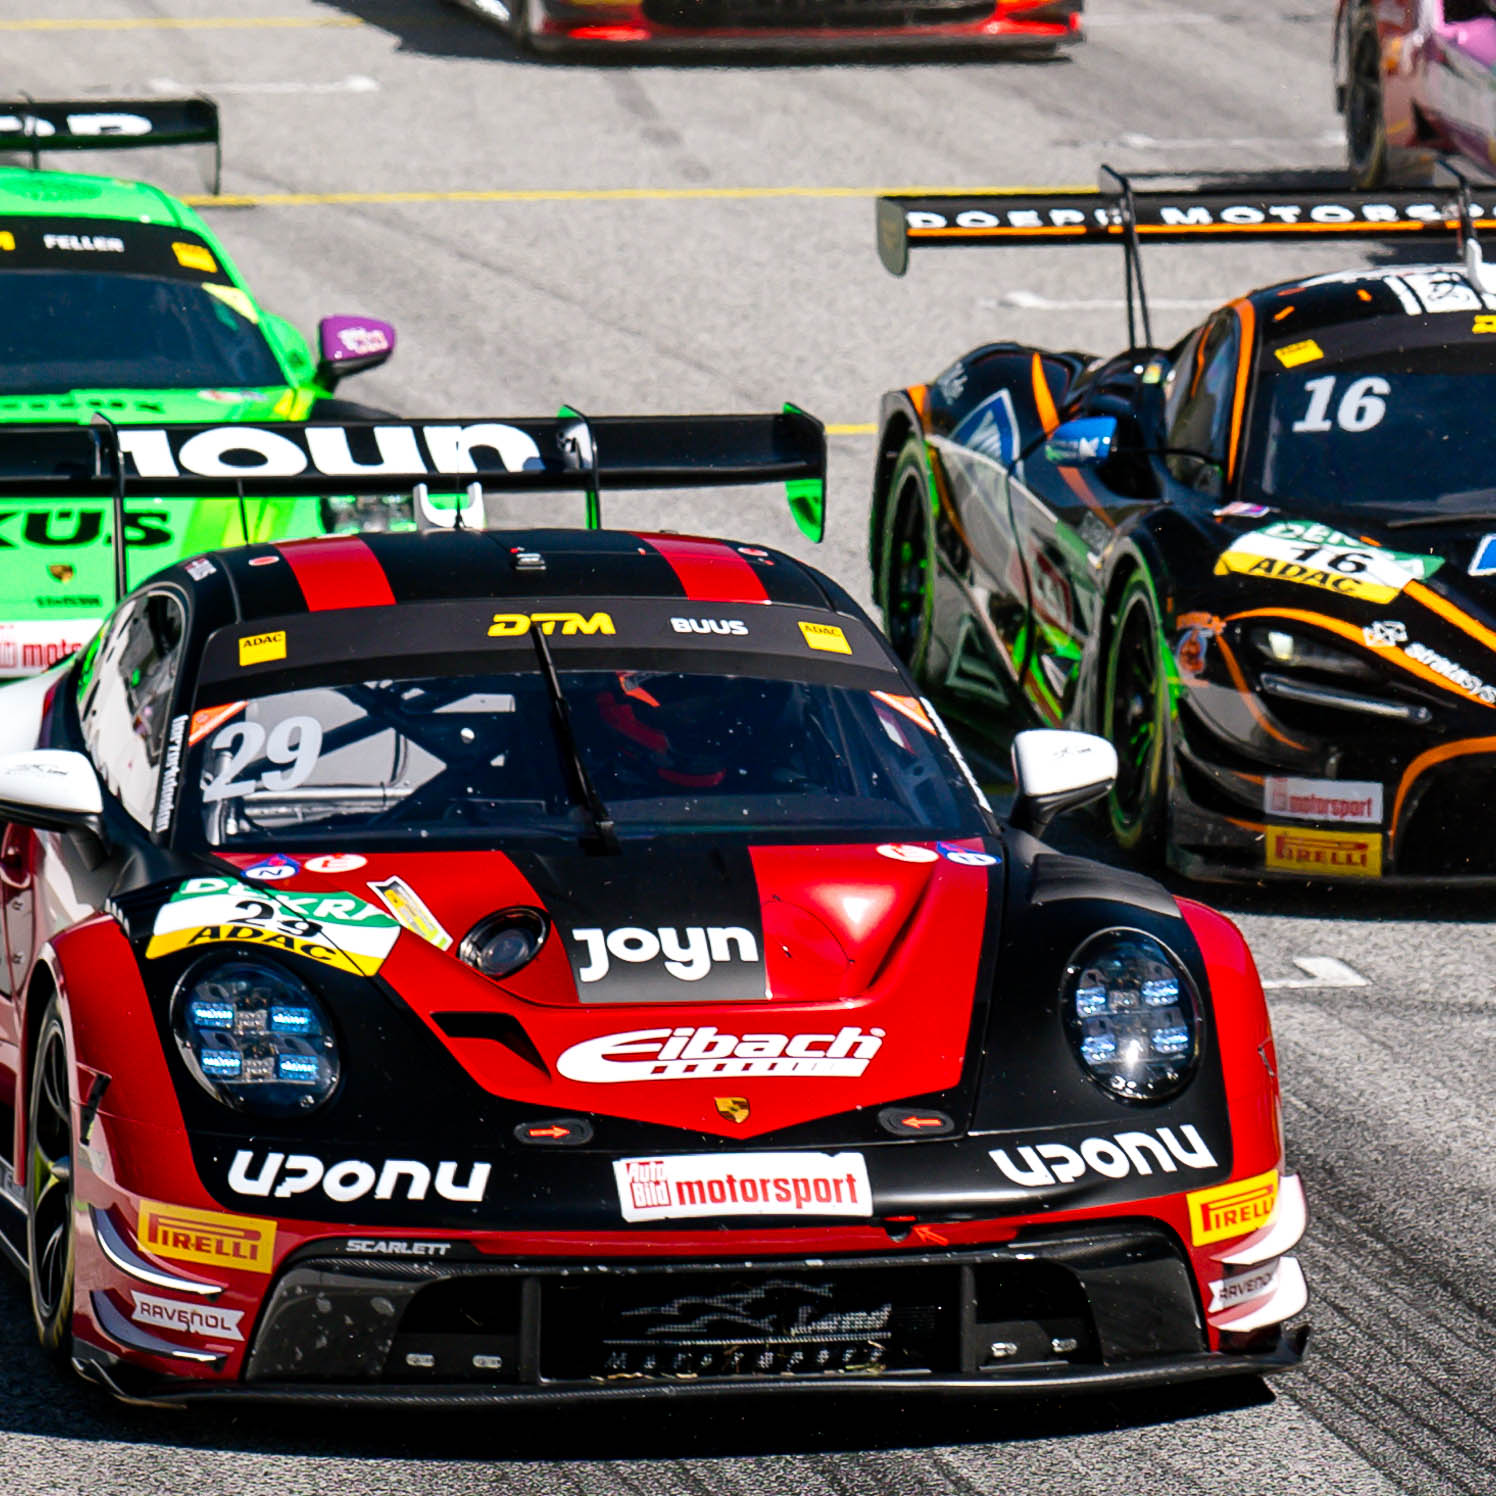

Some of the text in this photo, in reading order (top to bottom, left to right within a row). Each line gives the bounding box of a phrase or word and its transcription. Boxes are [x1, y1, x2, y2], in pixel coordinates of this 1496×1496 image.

[43, 234, 126, 253] FELLER
[1292, 375, 1392, 433] 16
[1248, 557, 1364, 594] ADAC
[1280, 545, 1373, 575] 16
[242, 634, 283, 648] ADAC
[487, 612, 750, 637] DTM BUUS
[803, 625, 842, 638] ADAC
[202, 715, 323, 803] 29
[1275, 835, 1369, 867] PIRELLI
[226, 899, 323, 938] 29
[187, 925, 338, 961] ADAC
[572, 926, 760, 981] joyn
[556, 1026, 887, 1084] Eibach
[625, 1160, 668, 1183] Auto
[992, 1124, 1218, 1187] uponu
[227, 1150, 492, 1203] uponu
[676, 1174, 858, 1209] motorsport
[630, 1181, 673, 1209] Bild
[147, 1212, 262, 1262] PIRELLI
[345, 1238, 451, 1256] SCARLETT
[139, 1303, 233, 1333] RAVENOL
